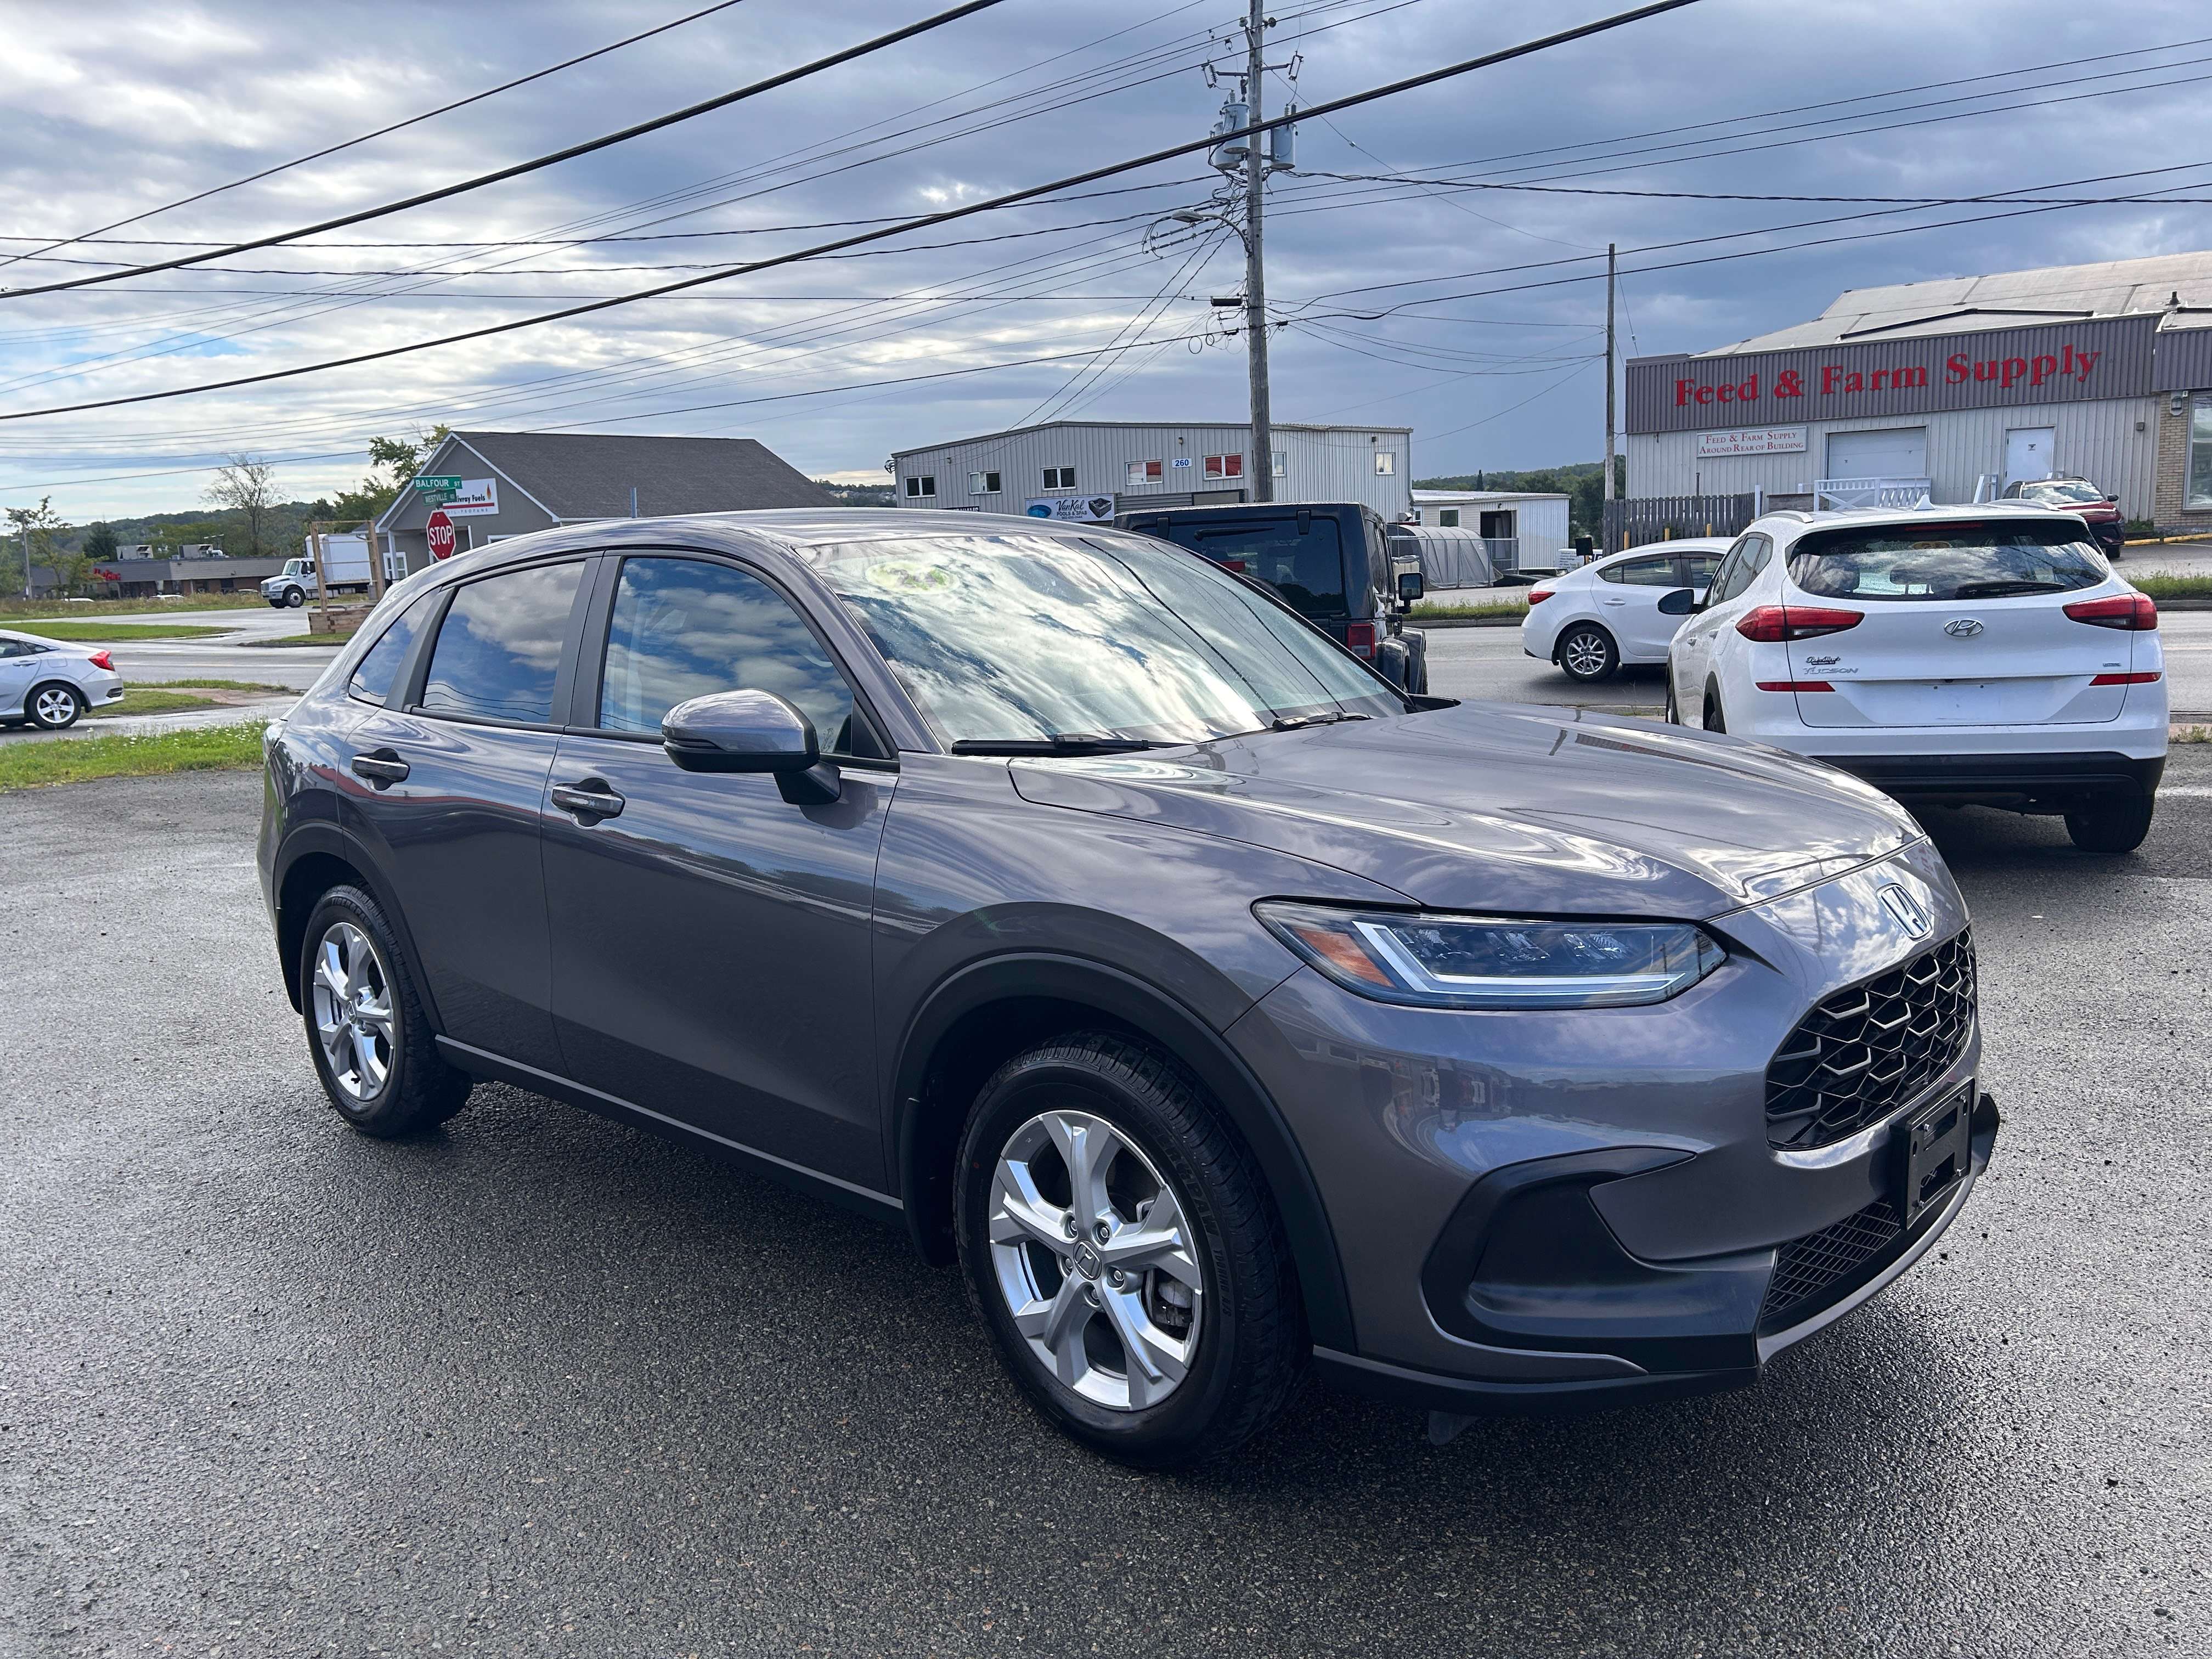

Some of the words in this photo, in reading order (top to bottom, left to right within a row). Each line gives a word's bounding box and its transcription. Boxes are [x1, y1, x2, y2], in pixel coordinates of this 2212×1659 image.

[1674, 374, 1759, 407] Feed
[1774, 369, 1804, 398] &
[1820, 365, 1928, 394] Farm
[1946, 343, 2102, 388] Supply
[1706, 434, 1726, 443] FEED
[1742, 433, 1763, 442] FARM
[1767, 430, 1797, 439] SUPPLY
[1699, 446, 1731, 454] AROUND
[1733, 444, 1756, 452] REAR
[1767, 442, 1803, 450] BUILDING
[415, 479, 449, 488] BALFOUR
[425, 493, 447, 503] WESTVILLE
[472, 493, 486, 502] Fuels
[1056, 499, 1085, 511] VanKal
[429, 525, 453, 545] STOP
